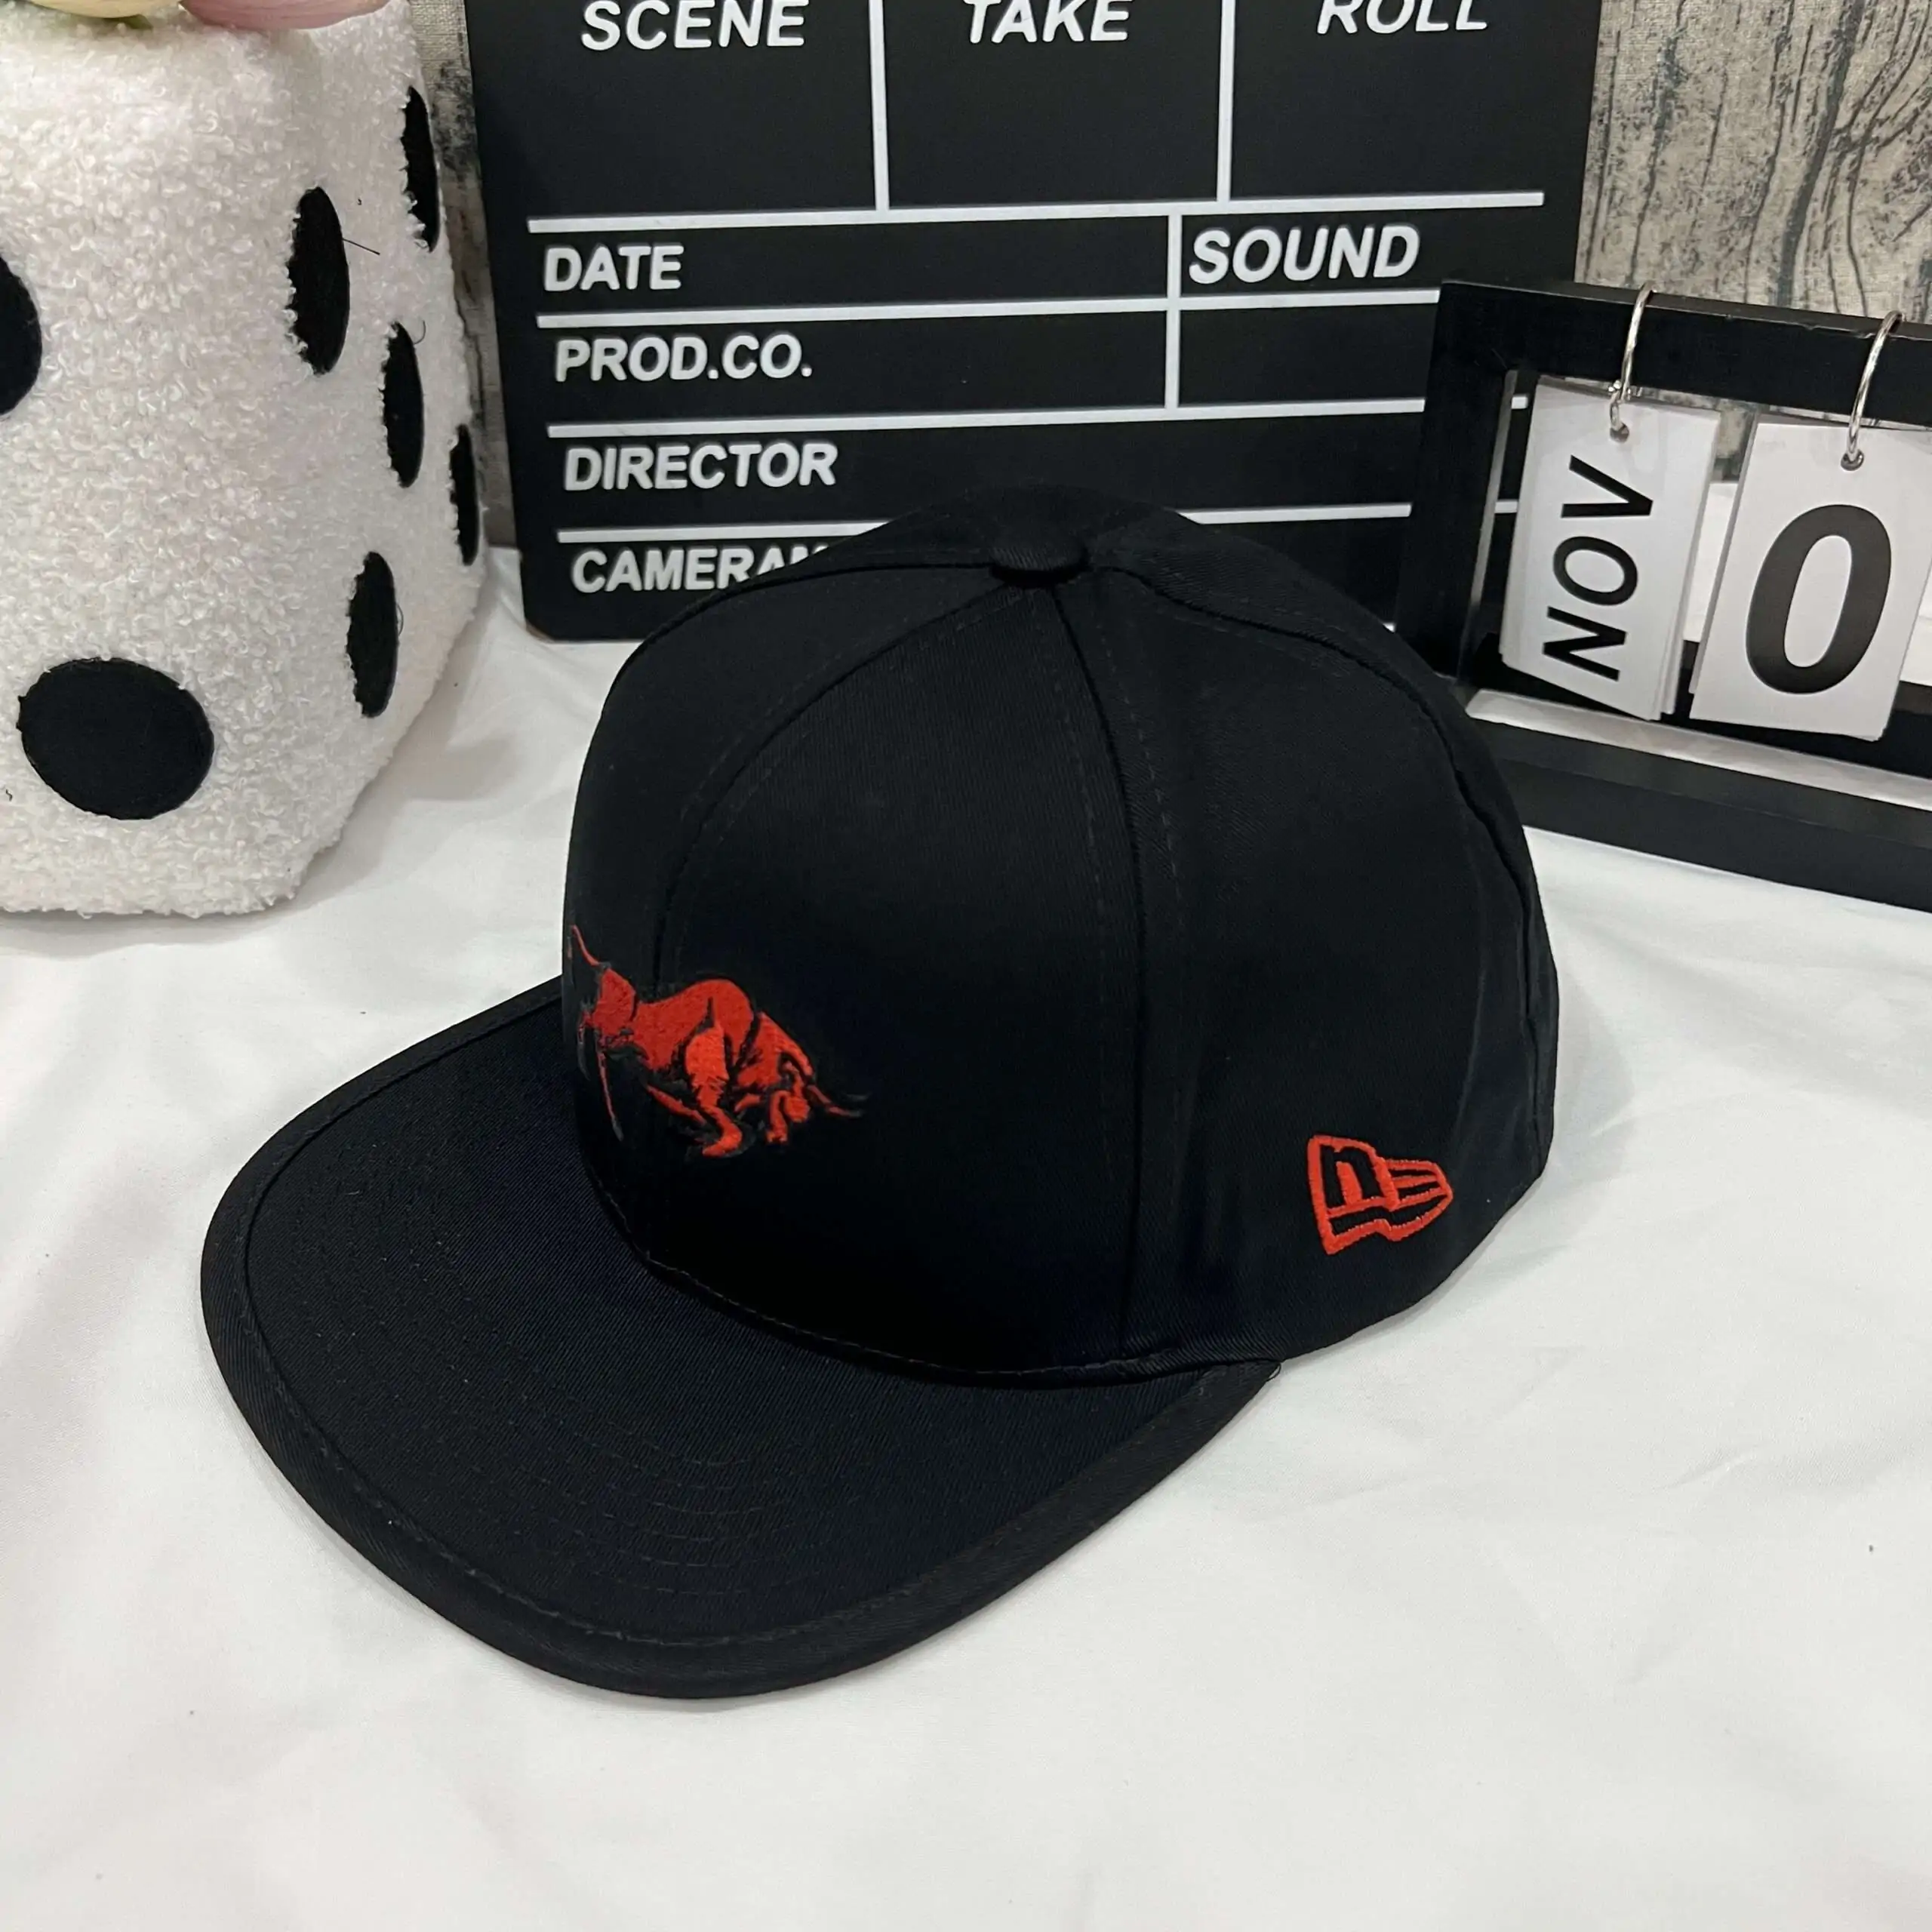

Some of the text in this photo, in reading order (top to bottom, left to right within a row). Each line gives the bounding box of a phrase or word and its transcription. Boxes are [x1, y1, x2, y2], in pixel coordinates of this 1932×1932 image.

[580, 0, 811, 51] SCENE
[962, 0, 1134, 44] TAKE
[1316, 0, 1488, 35] ROLL
[543, 245, 685, 291] DATE
[1188, 225, 1420, 285] SOUND
[555, 333, 813, 382] PROD.CO.
[565, 441, 838, 491] DIRECTOR
[1542, 454, 1654, 682] NOV
[1745, 503, 1893, 696] 0
